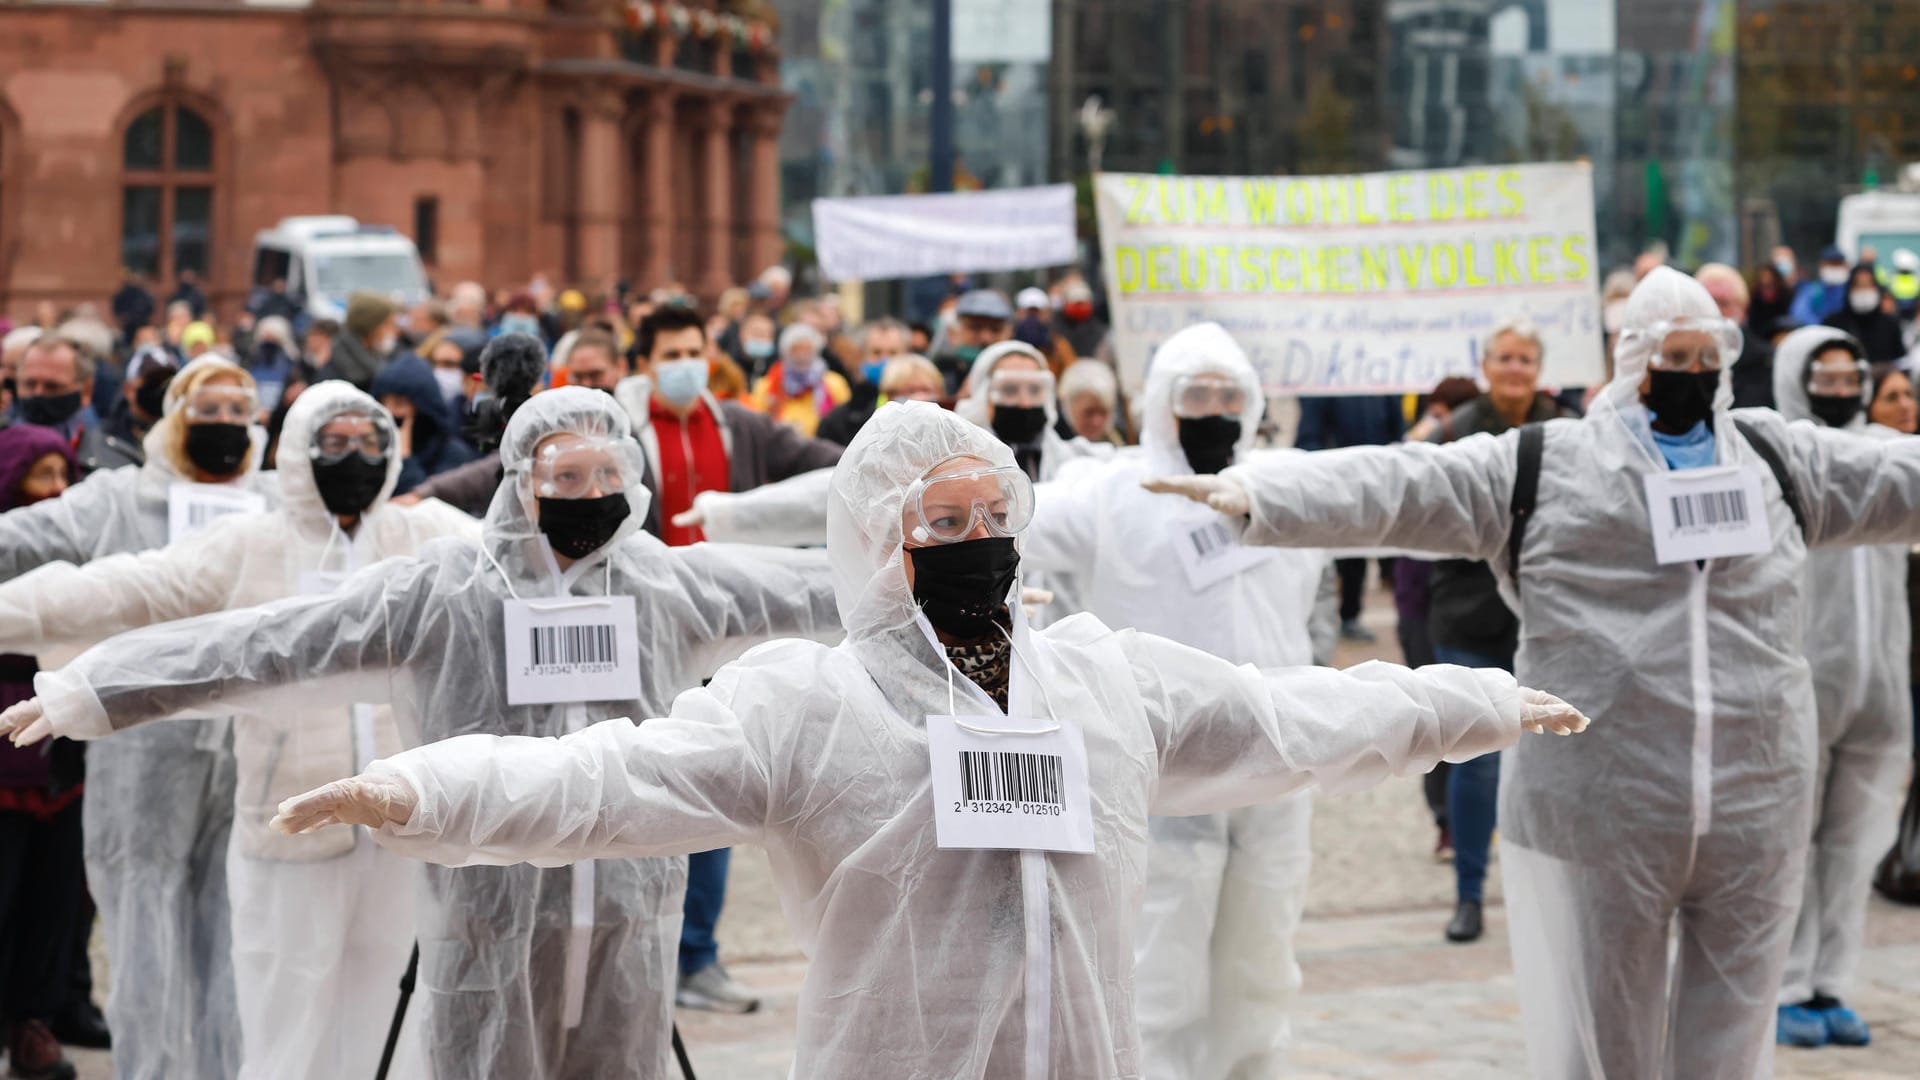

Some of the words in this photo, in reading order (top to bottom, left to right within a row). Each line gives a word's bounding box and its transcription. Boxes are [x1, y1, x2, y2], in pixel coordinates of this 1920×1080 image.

[1124, 177, 1229, 224] ZUM
[1242, 175, 1415, 225] WOHLE
[1427, 170, 1525, 220] DES
[1116, 244, 1387, 293] DEUTSCHEN
[1397, 234, 1590, 290] VOLKES
[537, 665, 571, 676] 312342
[580, 663, 613, 673] 012510
[954, 801, 961, 813] 2
[971, 801, 1013, 814] 312342
[1023, 803, 1060, 816] 012510
